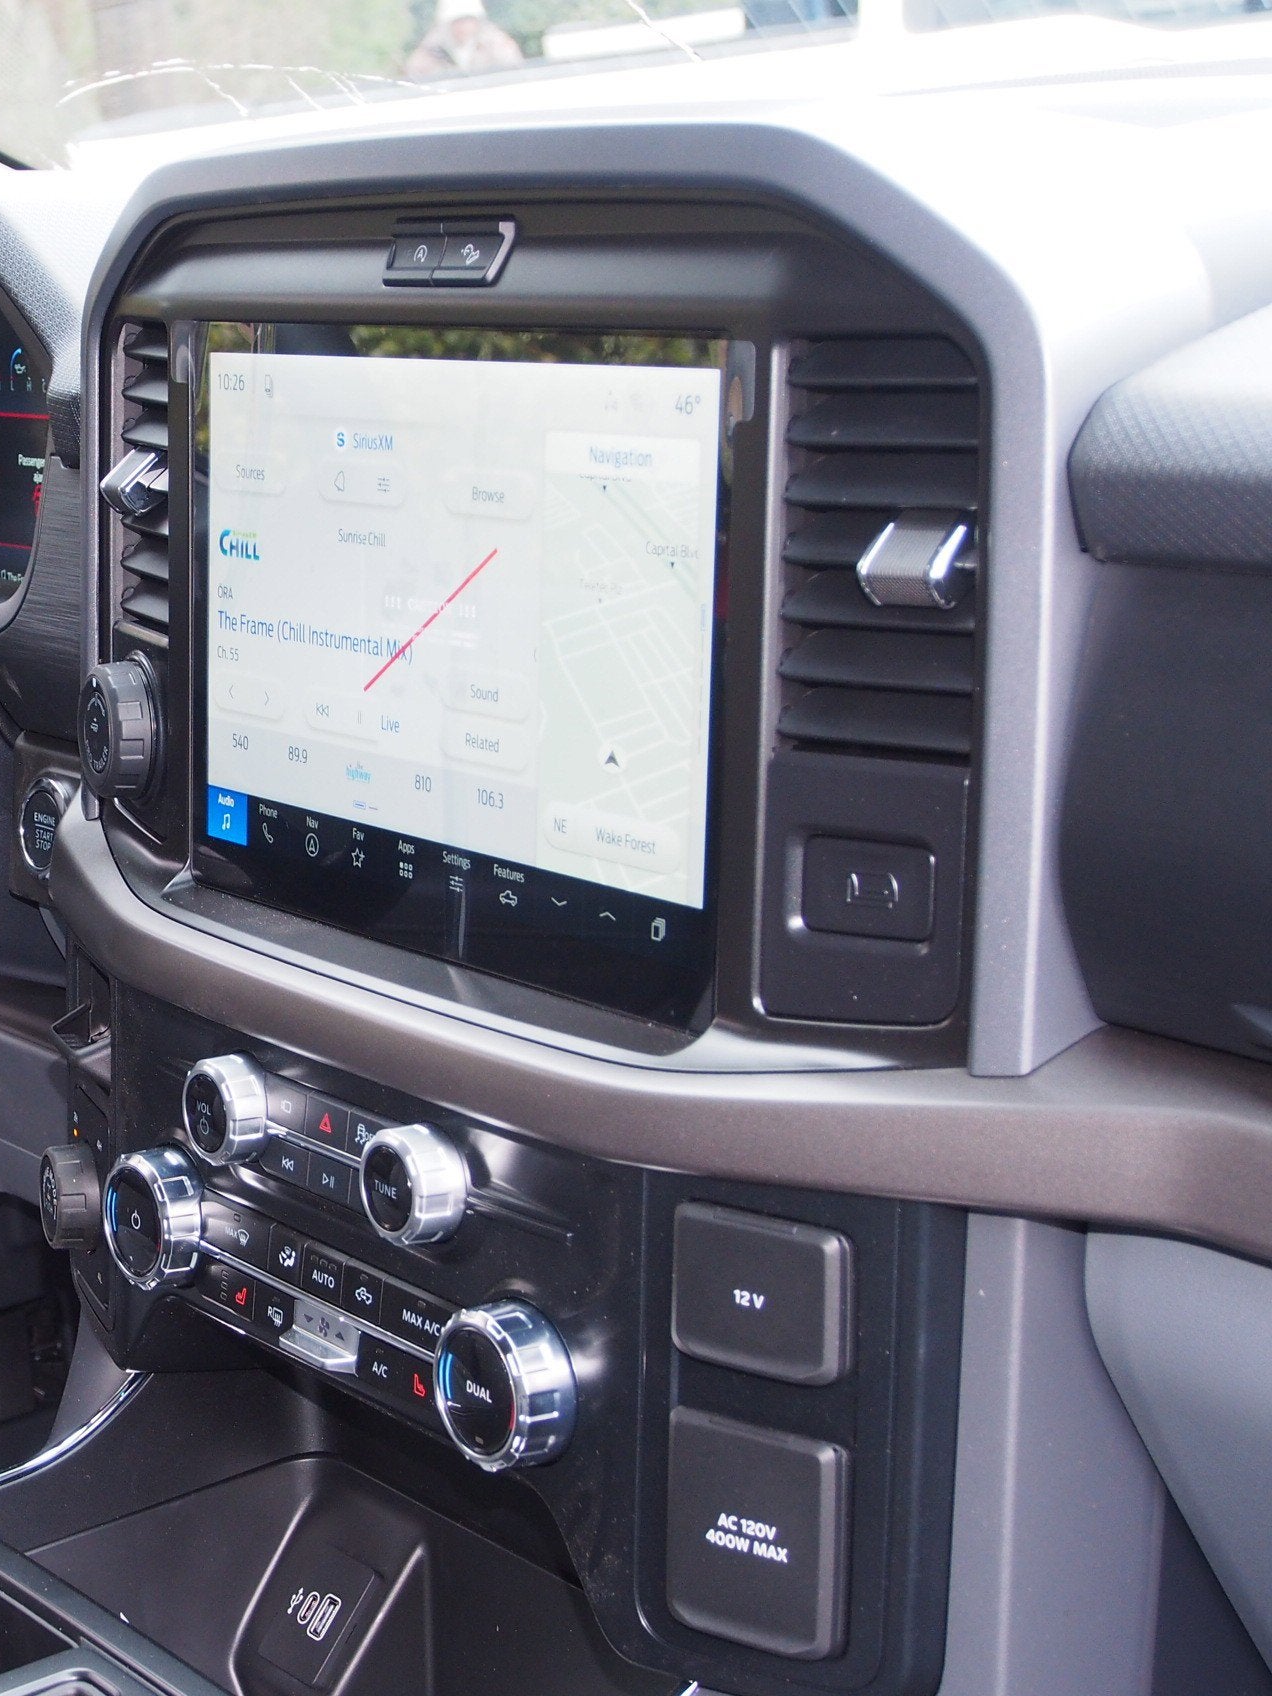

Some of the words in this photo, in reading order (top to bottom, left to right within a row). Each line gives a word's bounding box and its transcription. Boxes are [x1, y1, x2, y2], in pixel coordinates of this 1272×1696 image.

[218, 373, 245, 391] 10:26
[353, 432, 394, 450] SiriusXM
[589, 446, 653, 468] Navigation
[235, 464, 266, 481] Sources
[472, 486, 505, 504] Browse
[338, 528, 367, 546] Sunrise
[368, 531, 386, 547] Chill
[646, 541, 678, 558] Capital
[218, 610, 238, 632] The
[240, 614, 274, 638] Frame
[278, 618, 306, 644] (Chill
[308, 625, 384, 658] Instrumental
[229, 648, 240, 662] 55
[470, 684, 499, 702] Sound
[381, 715, 400, 733] Live
[232, 733, 249, 751] 540
[465, 732, 500, 753] Related
[288, 746, 308, 764] 89.9
[414, 775, 432, 792] 810
[217, 792, 235, 808] Audio
[476, 788, 504, 810] 106.3
[34, 812, 56, 827] ENGINE
[258, 804, 278, 820] Phone
[306, 816, 319, 830] Nav
[554, 818, 568, 834] NE
[35, 829, 54, 842] START
[352, 828, 365, 842] Fav
[596, 827, 622, 847] Wake
[624, 834, 656, 855] Forest
[35, 839, 52, 851] STOP
[398, 840, 416, 856] Apps
[442, 850, 472, 870] Settings
[493, 863, 526, 883] Features
[196, 1100, 211, 1116] VOL
[374, 1179, 398, 1200] TUNE
[312, 1269, 335, 1289] AUTO
[402, 1308, 423, 1328] MAX
[423, 1318, 441, 1338] A/C
[372, 1360, 388, 1378] A/C
[466, 1380, 492, 1404] DUAL
[717, 1512, 737, 1531] AC
[740, 1518, 778, 1541] 120V
[705, 1527, 750, 1554] 400W
[752, 1538, 789, 1564] MAX
